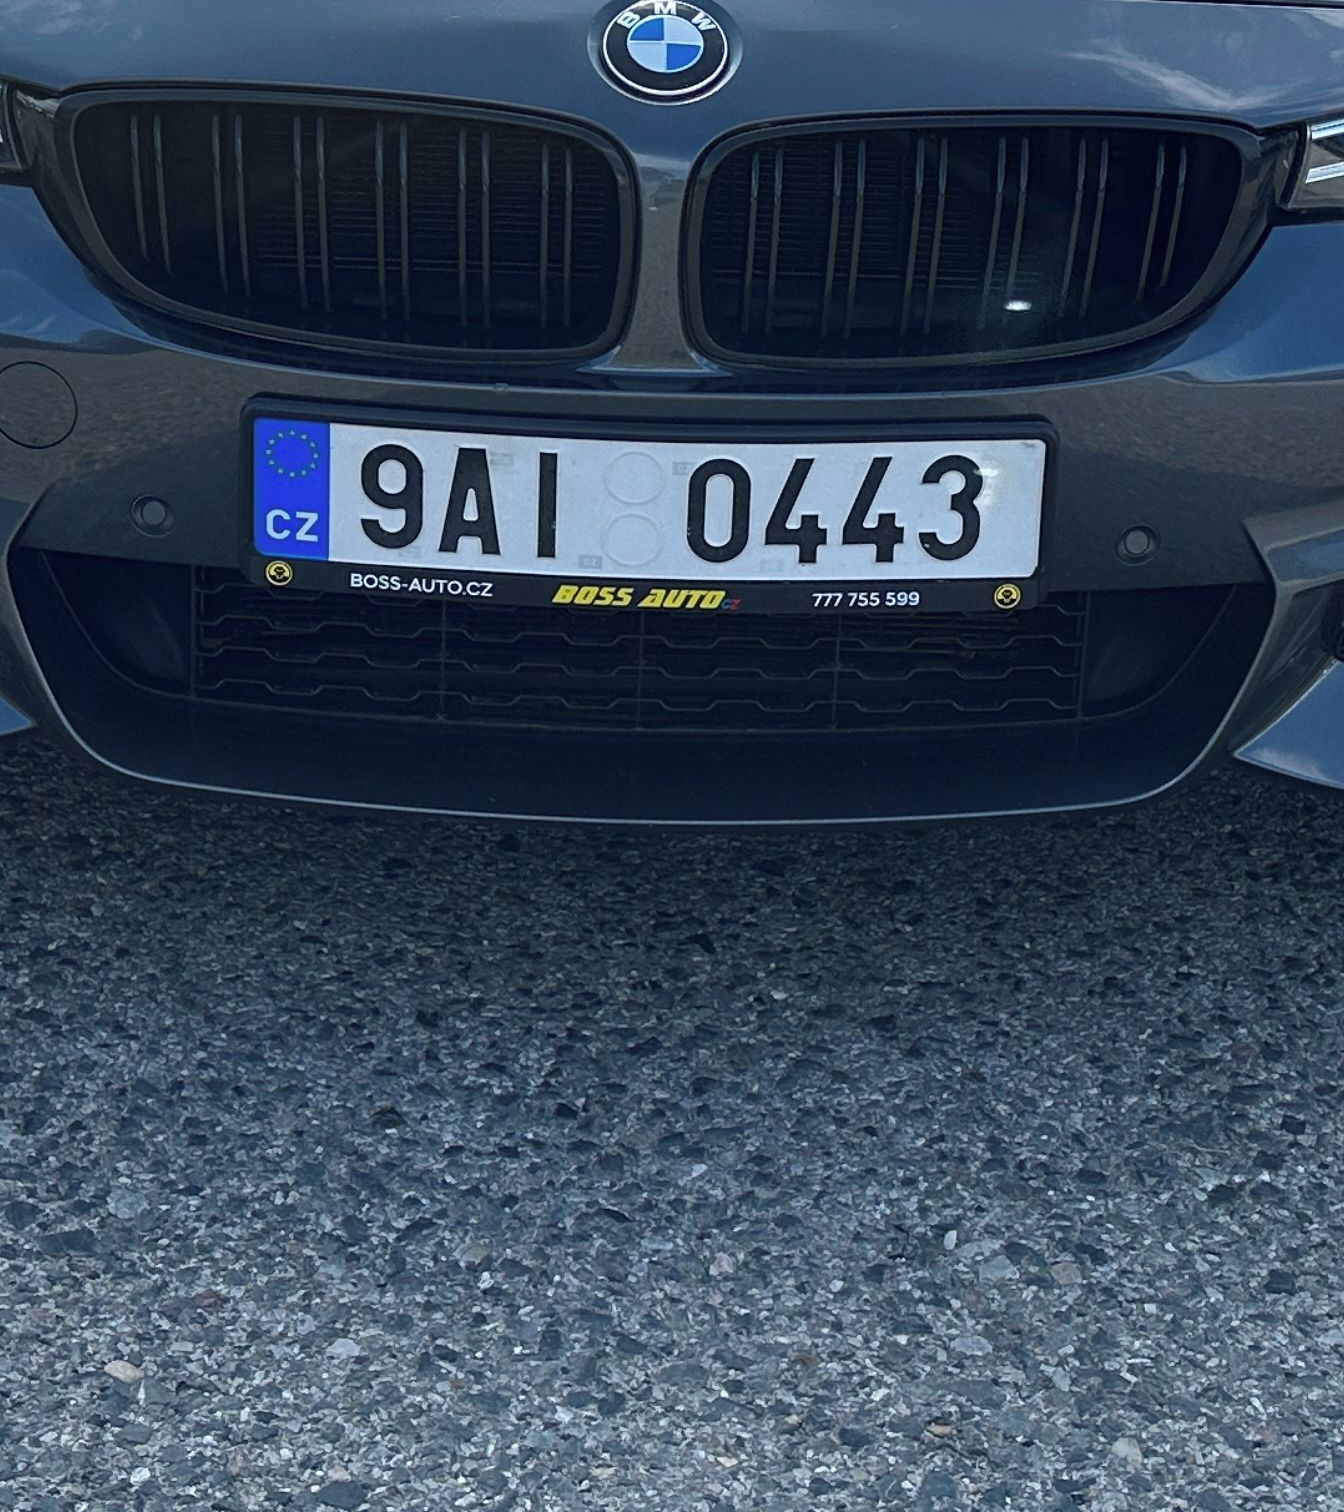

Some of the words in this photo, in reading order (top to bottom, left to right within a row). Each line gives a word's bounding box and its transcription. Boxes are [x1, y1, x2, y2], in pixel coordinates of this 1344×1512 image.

[616, 1, 716, 31] BMW
[360, 444, 557, 559] 9AI
[687, 455, 983, 564] 0443
[266, 509, 319, 542] CZ
[350, 573, 493, 597] BOSS-AUTO.CZ
[552, 584, 634, 607] BOSS
[637, 588, 727, 610] AUTO
[812, 592, 843, 607] 777
[848, 592, 880, 607] 755
[885, 591, 920, 606] 599
